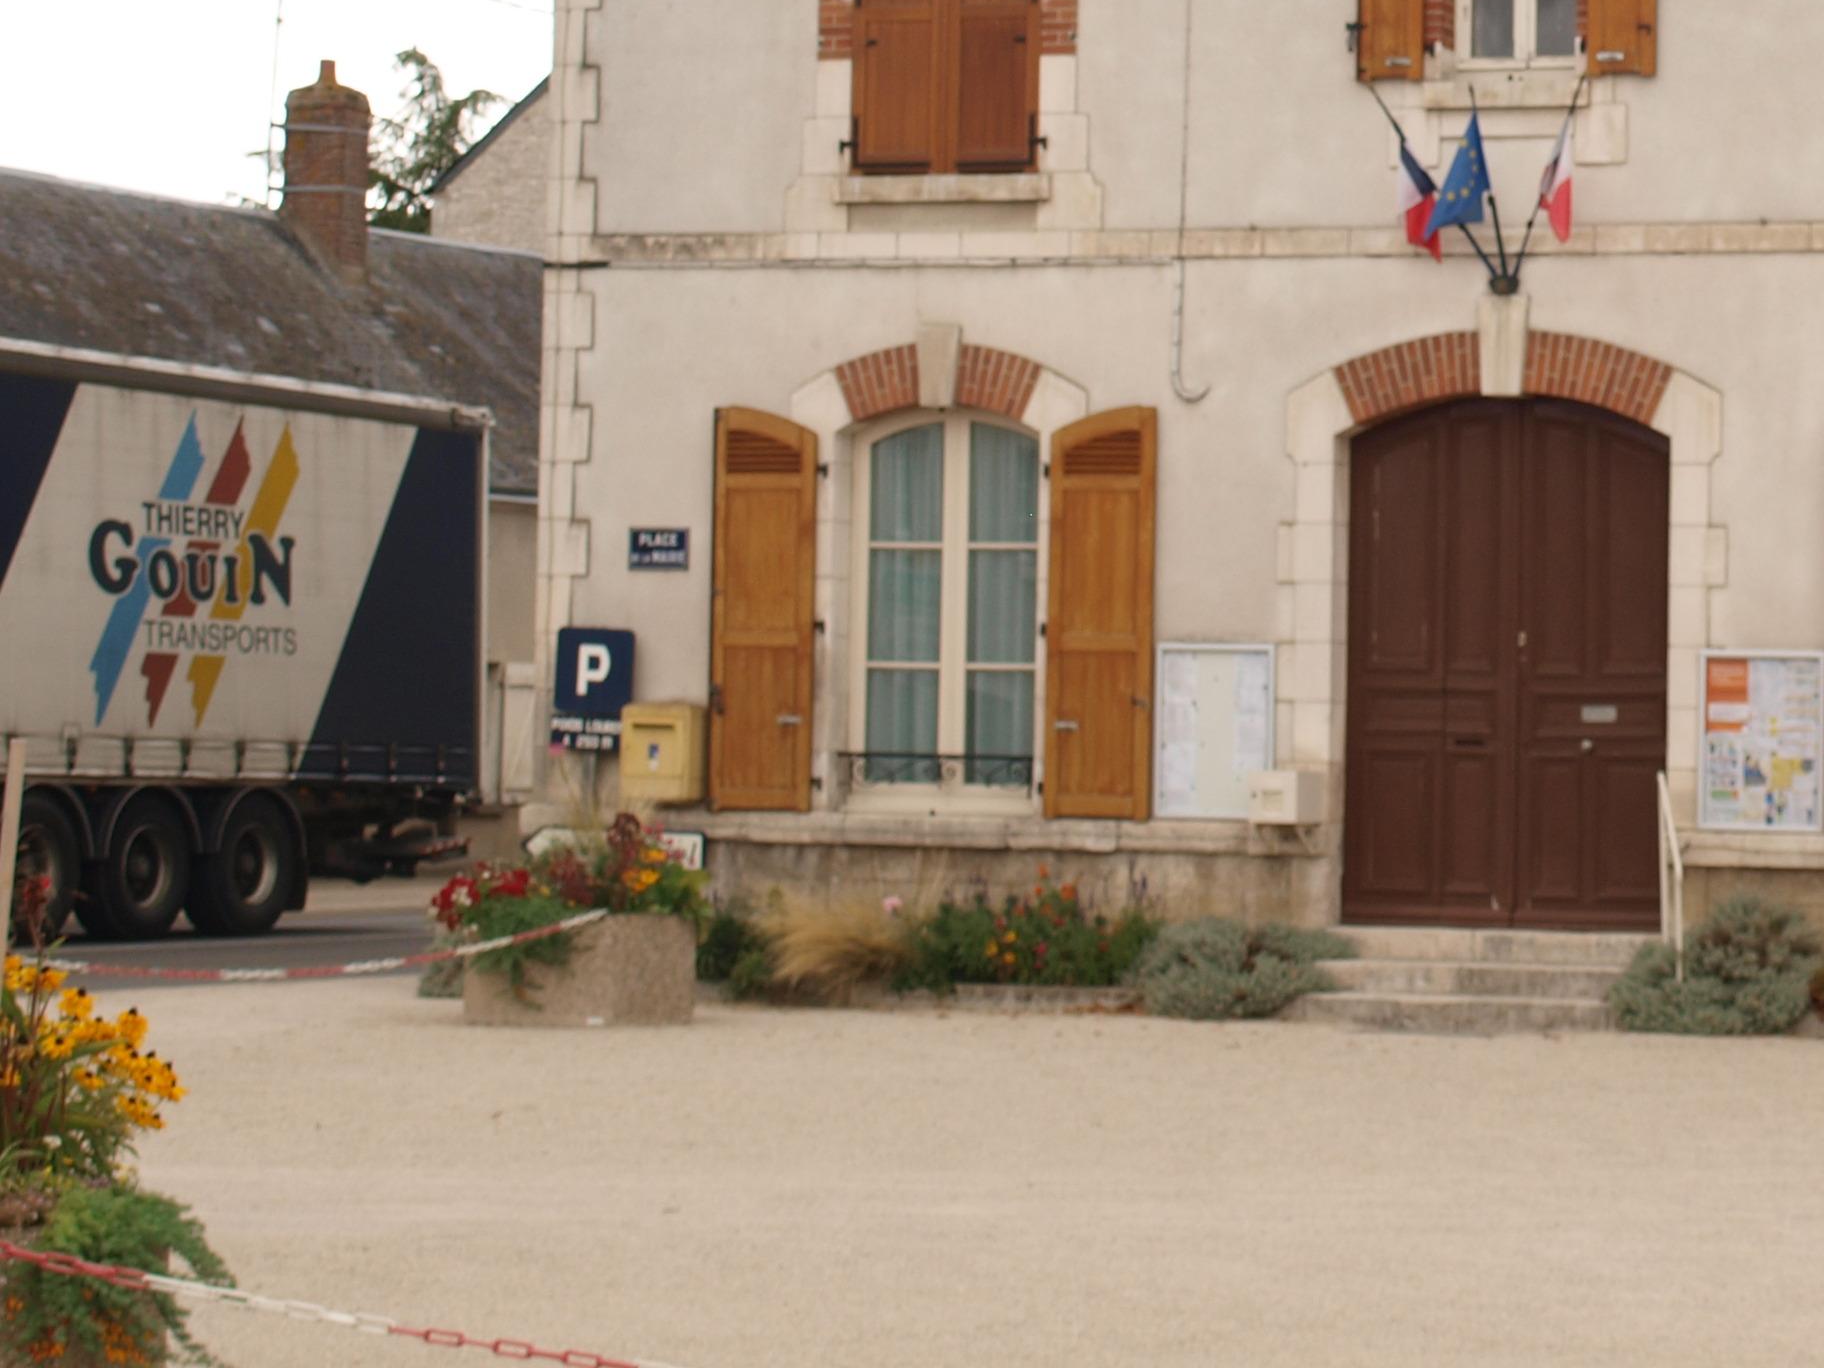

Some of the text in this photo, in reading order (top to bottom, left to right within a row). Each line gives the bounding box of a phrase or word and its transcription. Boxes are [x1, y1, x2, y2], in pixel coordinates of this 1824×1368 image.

[142, 501, 245, 539] THIERRY
[638, 532, 678, 547] PLACE
[88, 519, 295, 608] GOUIN
[144, 618, 298, 656] TRANSPORTS
[575, 643, 611, 697] P
